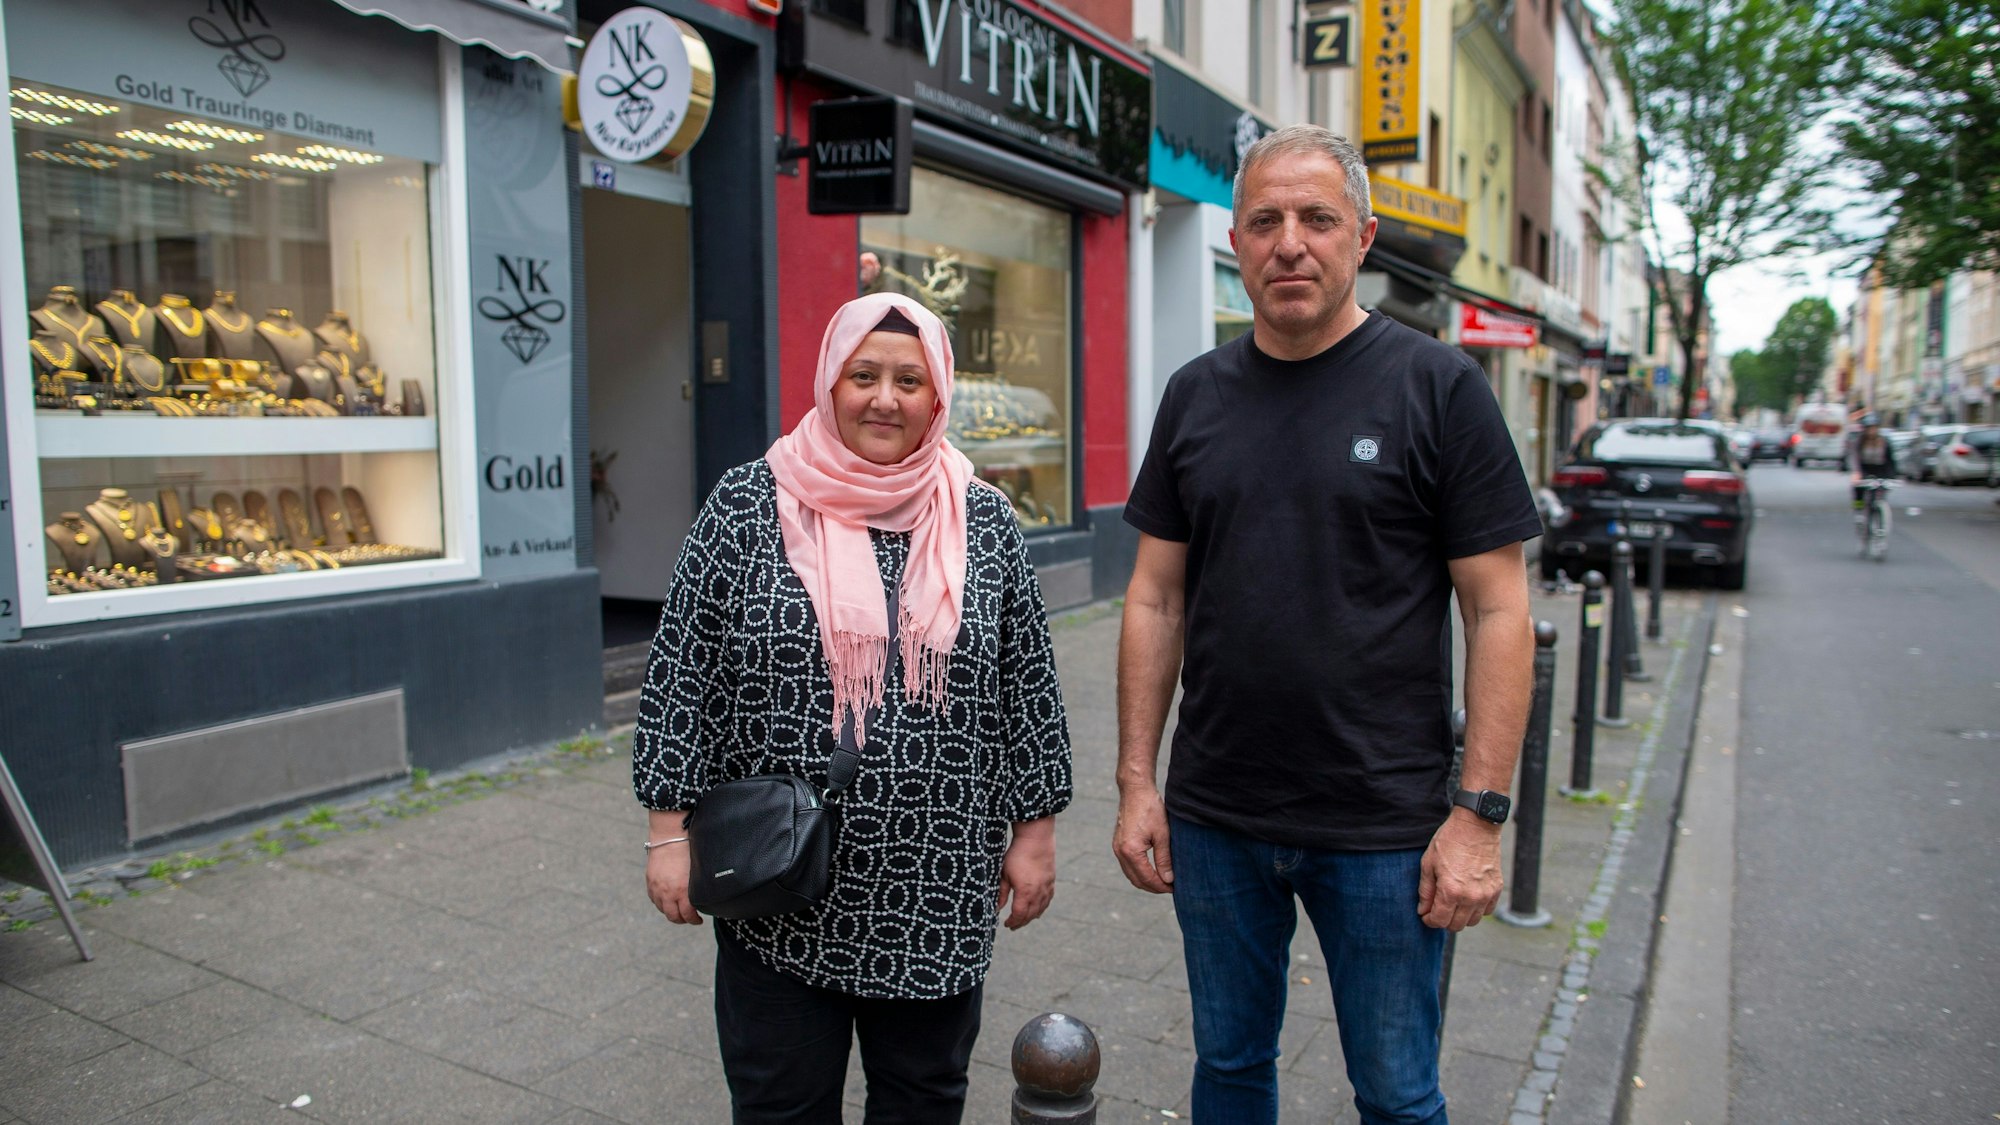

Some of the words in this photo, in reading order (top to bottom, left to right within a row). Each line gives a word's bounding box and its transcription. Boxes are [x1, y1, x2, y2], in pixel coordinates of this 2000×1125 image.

[608, 21, 656, 67] NK
[1313, 24, 1341, 60] Z
[917, 0, 1101, 138] VITRIN
[115, 74, 173, 104] Gold
[181, 88, 287, 129] Trauringe
[294, 111, 374, 146] Diamant
[816, 137, 894, 164] VITRIN
[495, 253, 551, 294] NK
[485, 454, 564, 493] Gold
[509, 540, 520, 556] &
